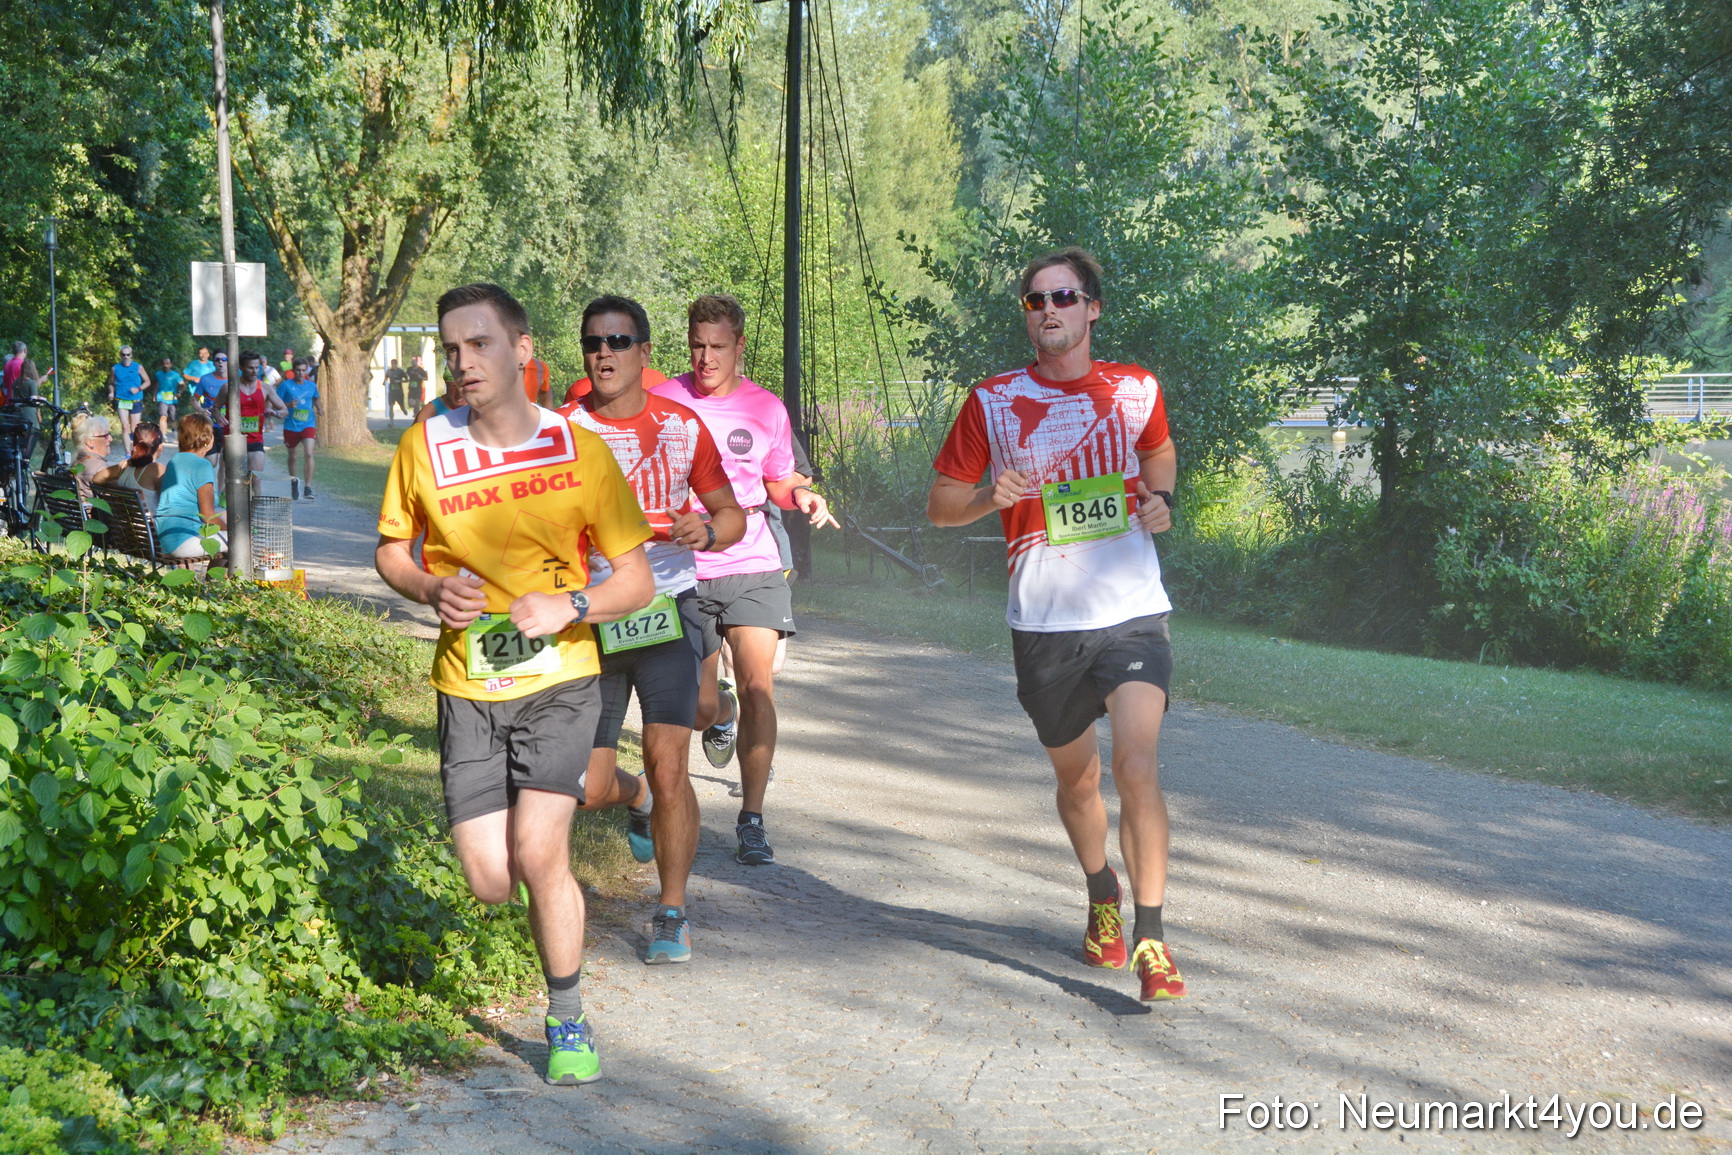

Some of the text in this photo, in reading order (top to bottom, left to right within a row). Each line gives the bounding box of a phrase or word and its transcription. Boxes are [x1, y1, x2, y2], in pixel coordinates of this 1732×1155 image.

[439, 471, 582, 516] MAX BÖGL
[1056, 496, 1118, 526] 1846
[1087, 522, 1108, 530] Martin
[610, 612, 670, 640] 1872
[635, 630, 666, 641] Ferdinand
[476, 630, 546, 658] 1216
[1126, 661, 1144, 671] NB
